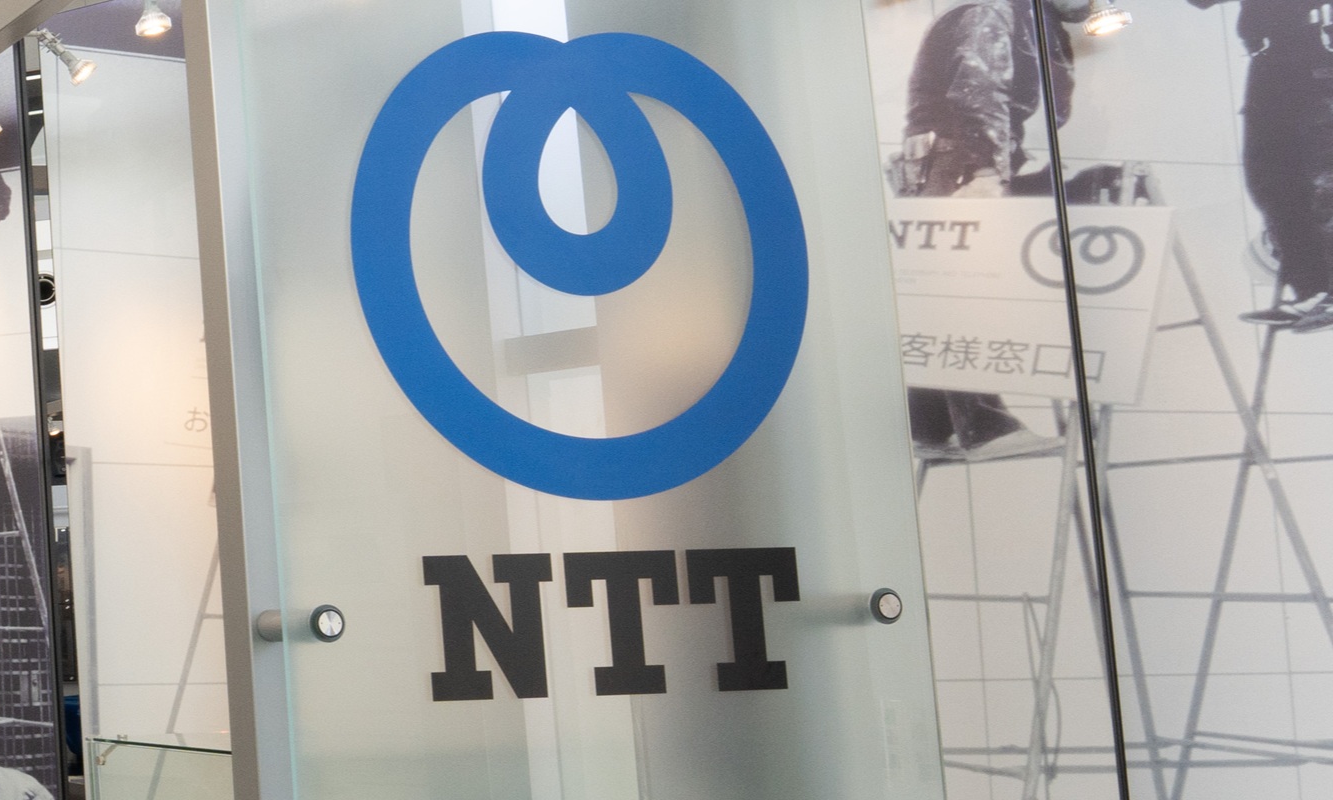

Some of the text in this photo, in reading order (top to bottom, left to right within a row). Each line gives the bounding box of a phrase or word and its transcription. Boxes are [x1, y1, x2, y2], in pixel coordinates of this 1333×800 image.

[889, 219, 980, 250] NTT
[184, 406, 211, 433] お
[421, 546, 800, 702] NTT
